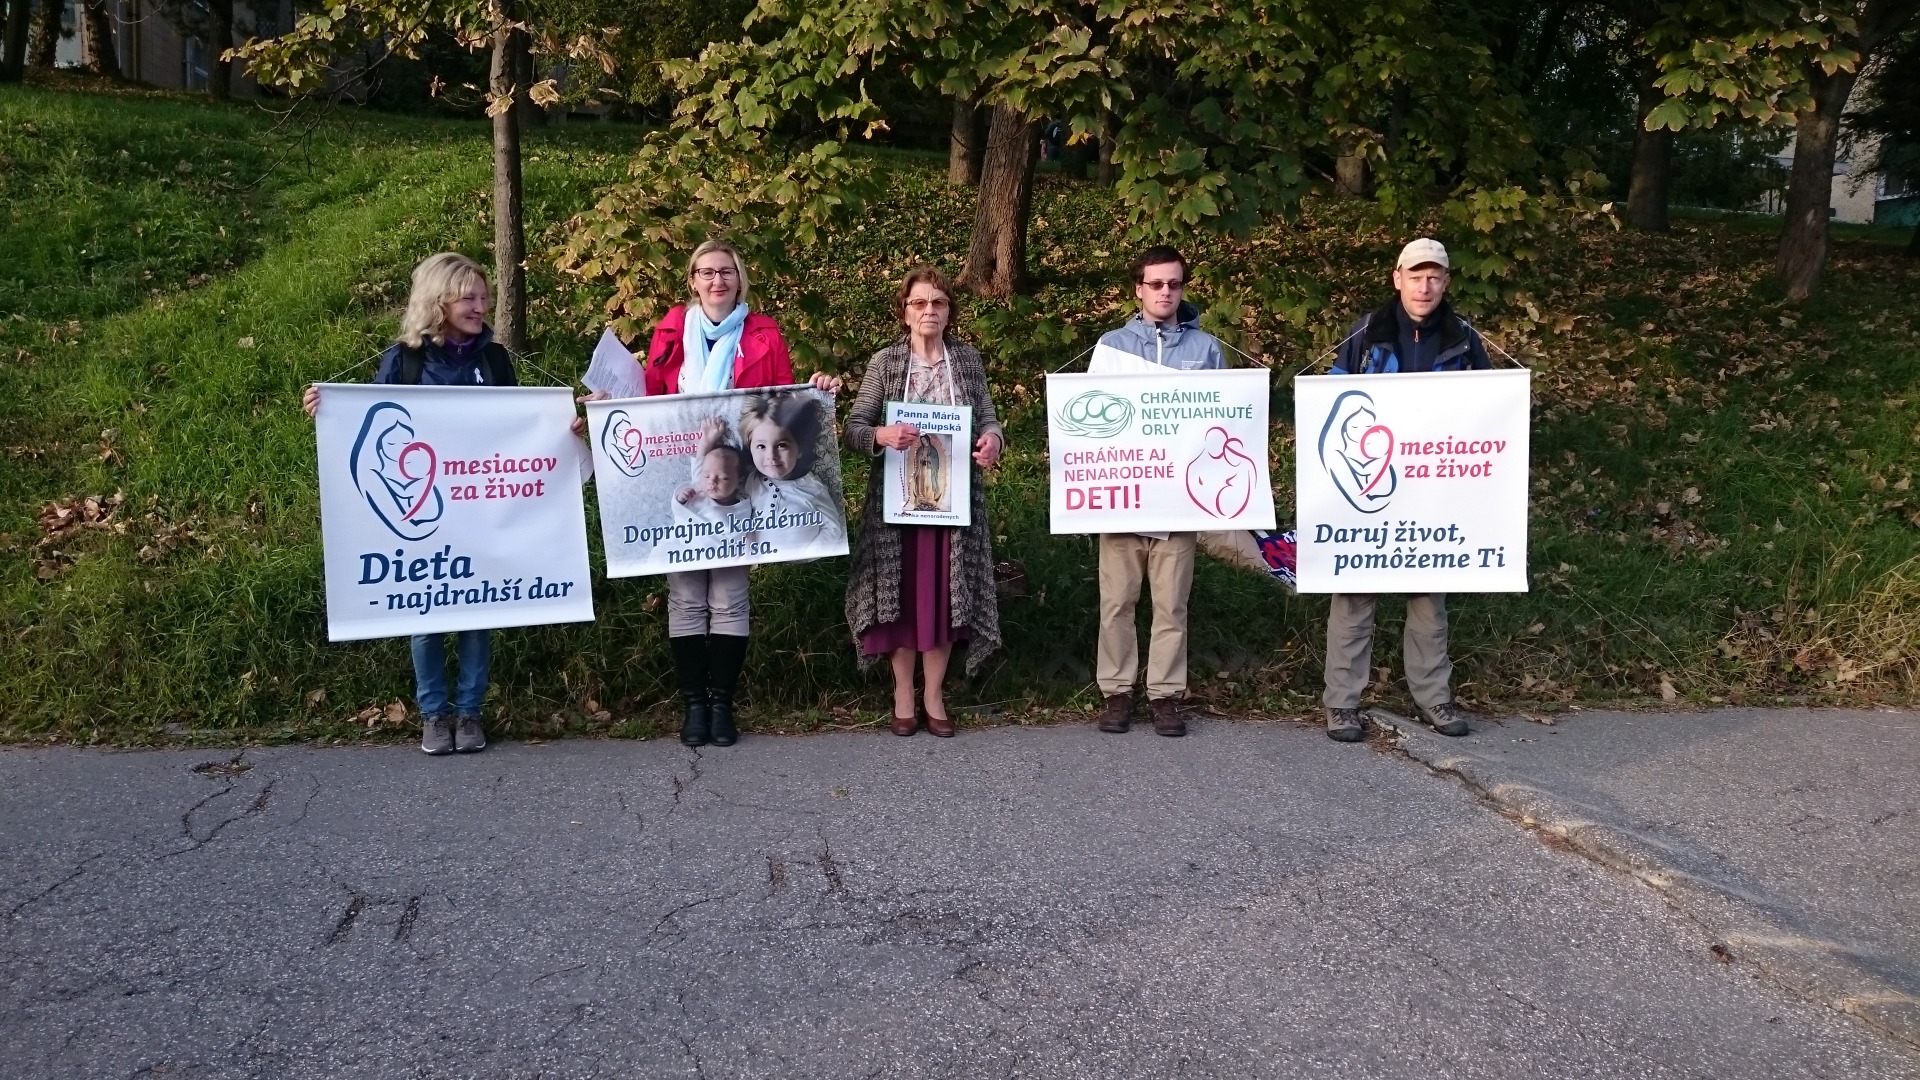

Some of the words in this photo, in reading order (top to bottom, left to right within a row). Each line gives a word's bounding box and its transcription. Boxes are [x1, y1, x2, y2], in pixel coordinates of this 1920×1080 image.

[1140, 389, 1221, 404] CHRÁNIME
[897, 409, 929, 419] Panna
[932, 411, 960, 421] Mária
[1141, 404, 1253, 420] NEVYLIAHNUTÉ
[644, 431, 703, 446] mesiacov
[1142, 423, 1180, 436] ORLY
[649, 448, 664, 458] za
[666, 443, 698, 457] život
[1063, 447, 1144, 465] CHRÁŇME
[1149, 448, 1166, 462] AJ
[1400, 435, 1506, 456] mesiacov
[443, 453, 557, 476] mesiacov
[1064, 462, 1175, 482] NENARODENÉ
[1404, 464, 1430, 478] za
[1436, 458, 1493, 478] život
[450, 484, 479, 500] za
[485, 478, 545, 499] život
[1065, 484, 1141, 510] DETI!
[623, 517, 725, 547] Doprajme
[727, 507, 823, 535] každému
[1314, 521, 1389, 549] Daruj
[1394, 520, 1466, 545] život,
[668, 537, 746, 564] narodiť
[750, 541, 779, 556] sa.
[358, 545, 475, 585] Dieťa
[1334, 547, 1470, 576] pomôžeme
[1478, 547, 1506, 568] Ti
[387, 578, 522, 615] najdrahší
[528, 577, 574, 600] dar
